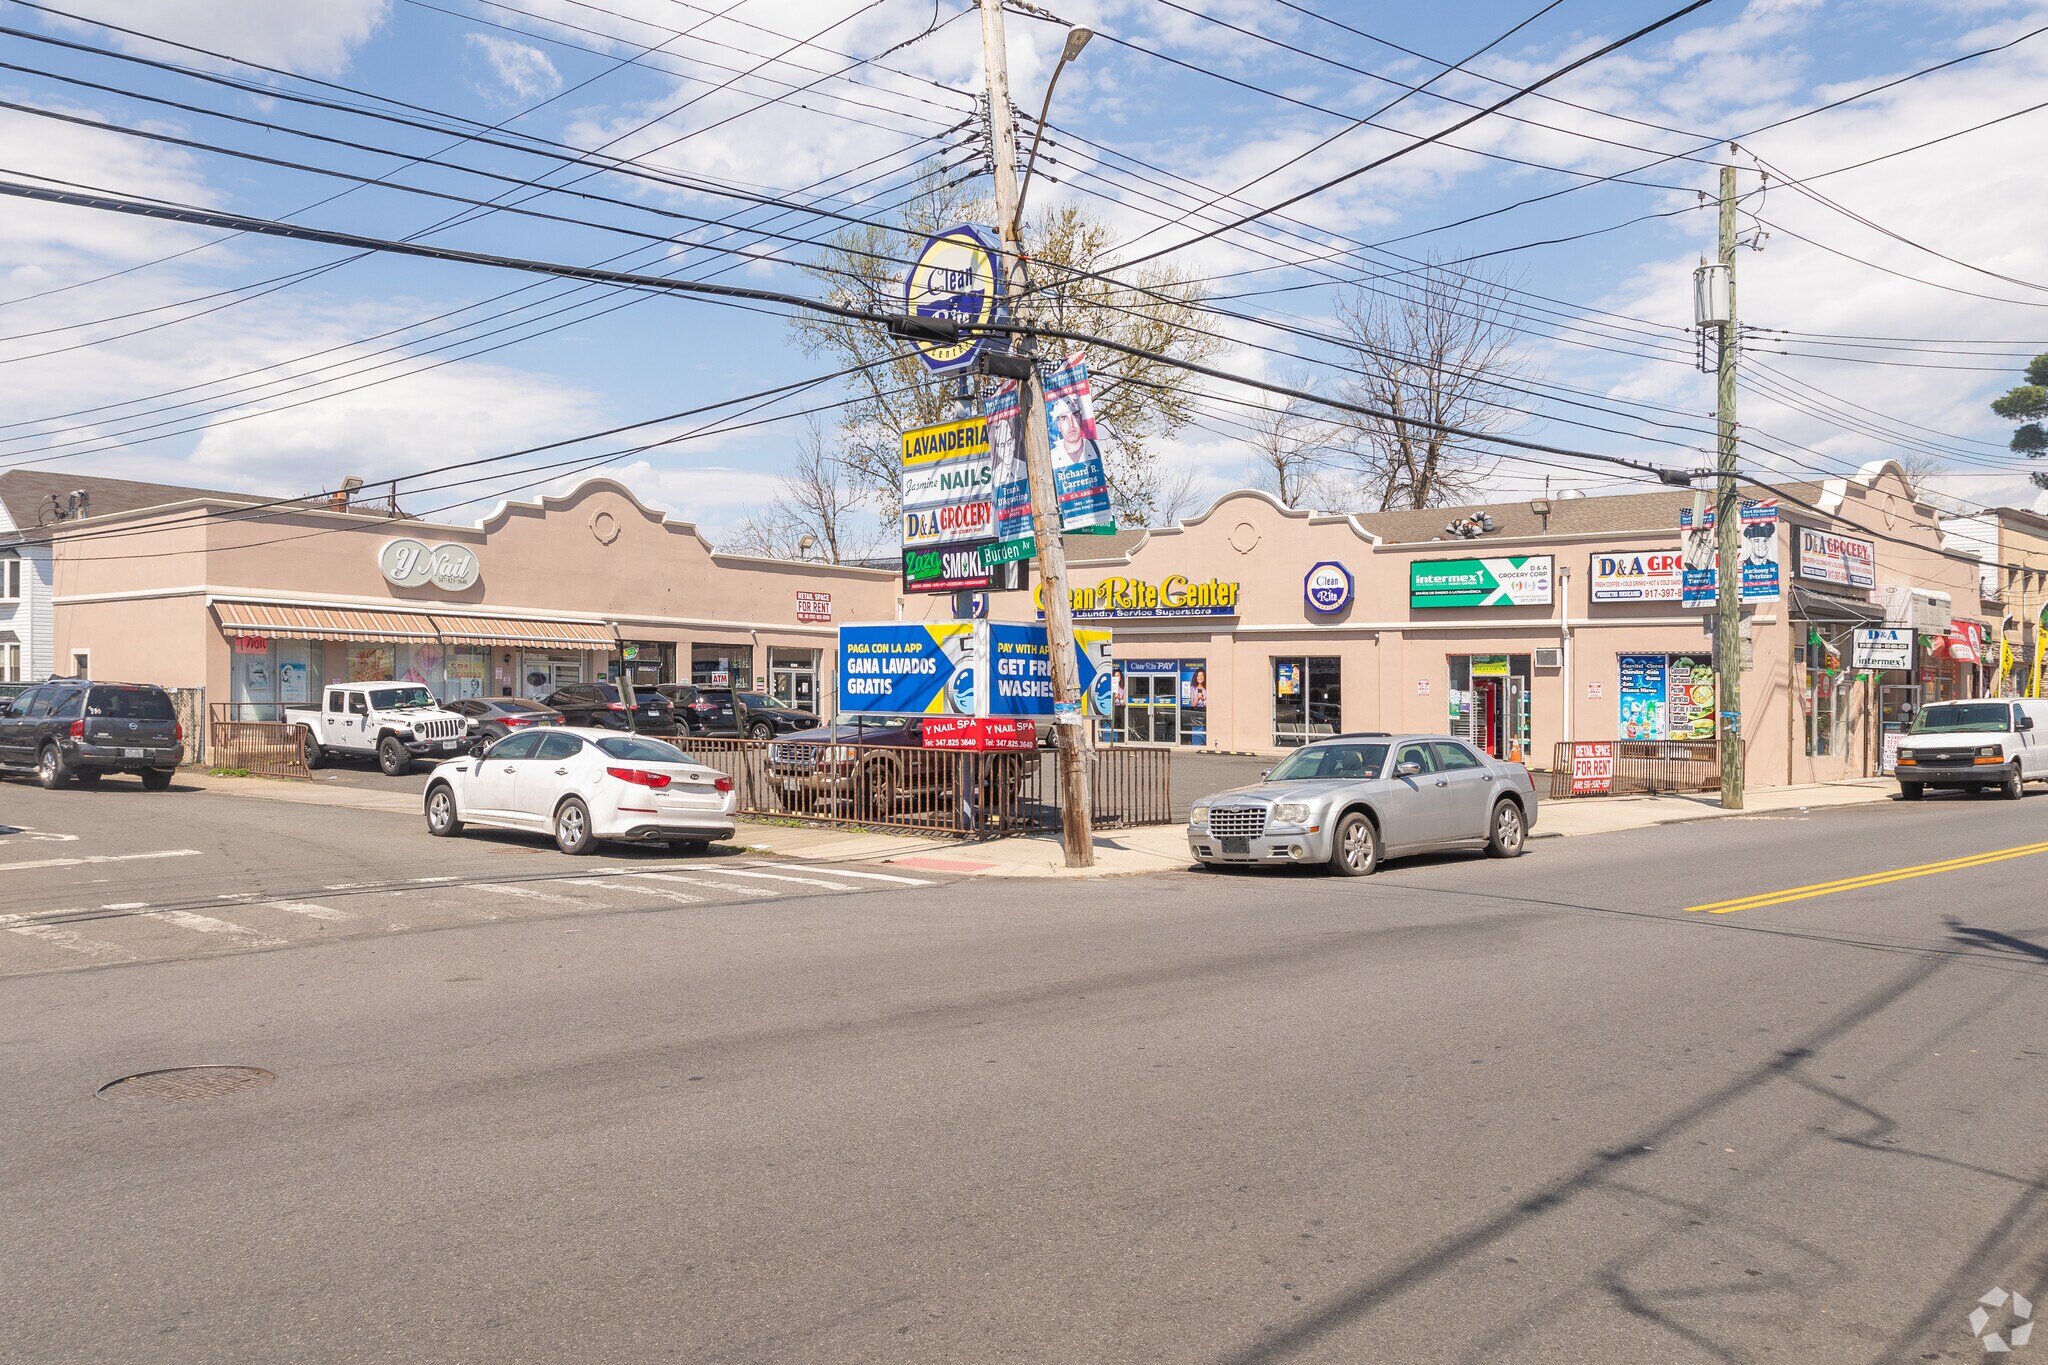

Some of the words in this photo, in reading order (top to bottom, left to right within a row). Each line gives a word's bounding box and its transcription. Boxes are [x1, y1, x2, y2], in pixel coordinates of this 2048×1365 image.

[928, 266, 973, 296] Clean
[905, 424, 989, 459] LAVANDERIA
[1057, 467, 1089, 481] Richard
[1090, 465, 1100, 474] R.
[905, 477, 938, 497] Jasmine
[940, 466, 992, 491] NAILS
[1062, 476, 1098, 490] Carreras
[906, 509, 940, 540] D&A
[940, 501, 993, 530] GROCERY
[984, 544, 1020, 563] Burden
[1022, 540, 1030, 550] Av
[1804, 532, 1827, 556] D&A
[1827, 538, 1868, 560] GROCERY
[417, 552, 471, 578] Nail
[905, 551, 941, 576] Zaza
[1599, 556, 1644, 578] D&A
[1316, 576, 1339, 586] Clean
[1415, 573, 1478, 584] intermex
[1097, 576, 1157, 609] Rite
[1159, 574, 1239, 607] Center
[1316, 590, 1338, 602] Rite
[798, 601, 811, 612] FOR
[812, 602, 830, 613] RENT
[1076, 609, 1114, 618] Laundry
[1116, 609, 1153, 617] Service
[1155, 608, 1212, 617] Superstore
[1868, 629, 1898, 640] D&A
[847, 643, 870, 654] PAGA
[871, 643, 890, 654] CON
[891, 643, 902, 653] LA
[904, 643, 923, 653] APP
[997, 643, 1014, 653] PAY
[1015, 643, 1037, 654] WITH
[1038, 644, 1050, 655] AP
[847, 658, 881, 674] GANA
[882, 658, 937, 675] LAVADOS
[998, 659, 1030, 676] GET
[1157, 662, 1175, 670] PAY
[1858, 655, 1900, 666] intermex
[713, 675, 727, 683] ATM
[847, 678, 893, 695] GRATIS
[925, 725, 932, 736] Y
[933, 722, 956, 734] NAIL
[956, 719, 977, 729] SPA
[985, 725, 992, 735] Y
[992, 724, 1016, 734] NAIL
[1016, 721, 1034, 730] SPA
[924, 739, 934, 747] Tel:
[984, 738, 995, 746] Tel:
[1575, 745, 1595, 757] RETAIL
[1595, 744, 1611, 757] SPACE
[1576, 760, 1592, 776] FOR
[1593, 759, 1611, 775] RENT
